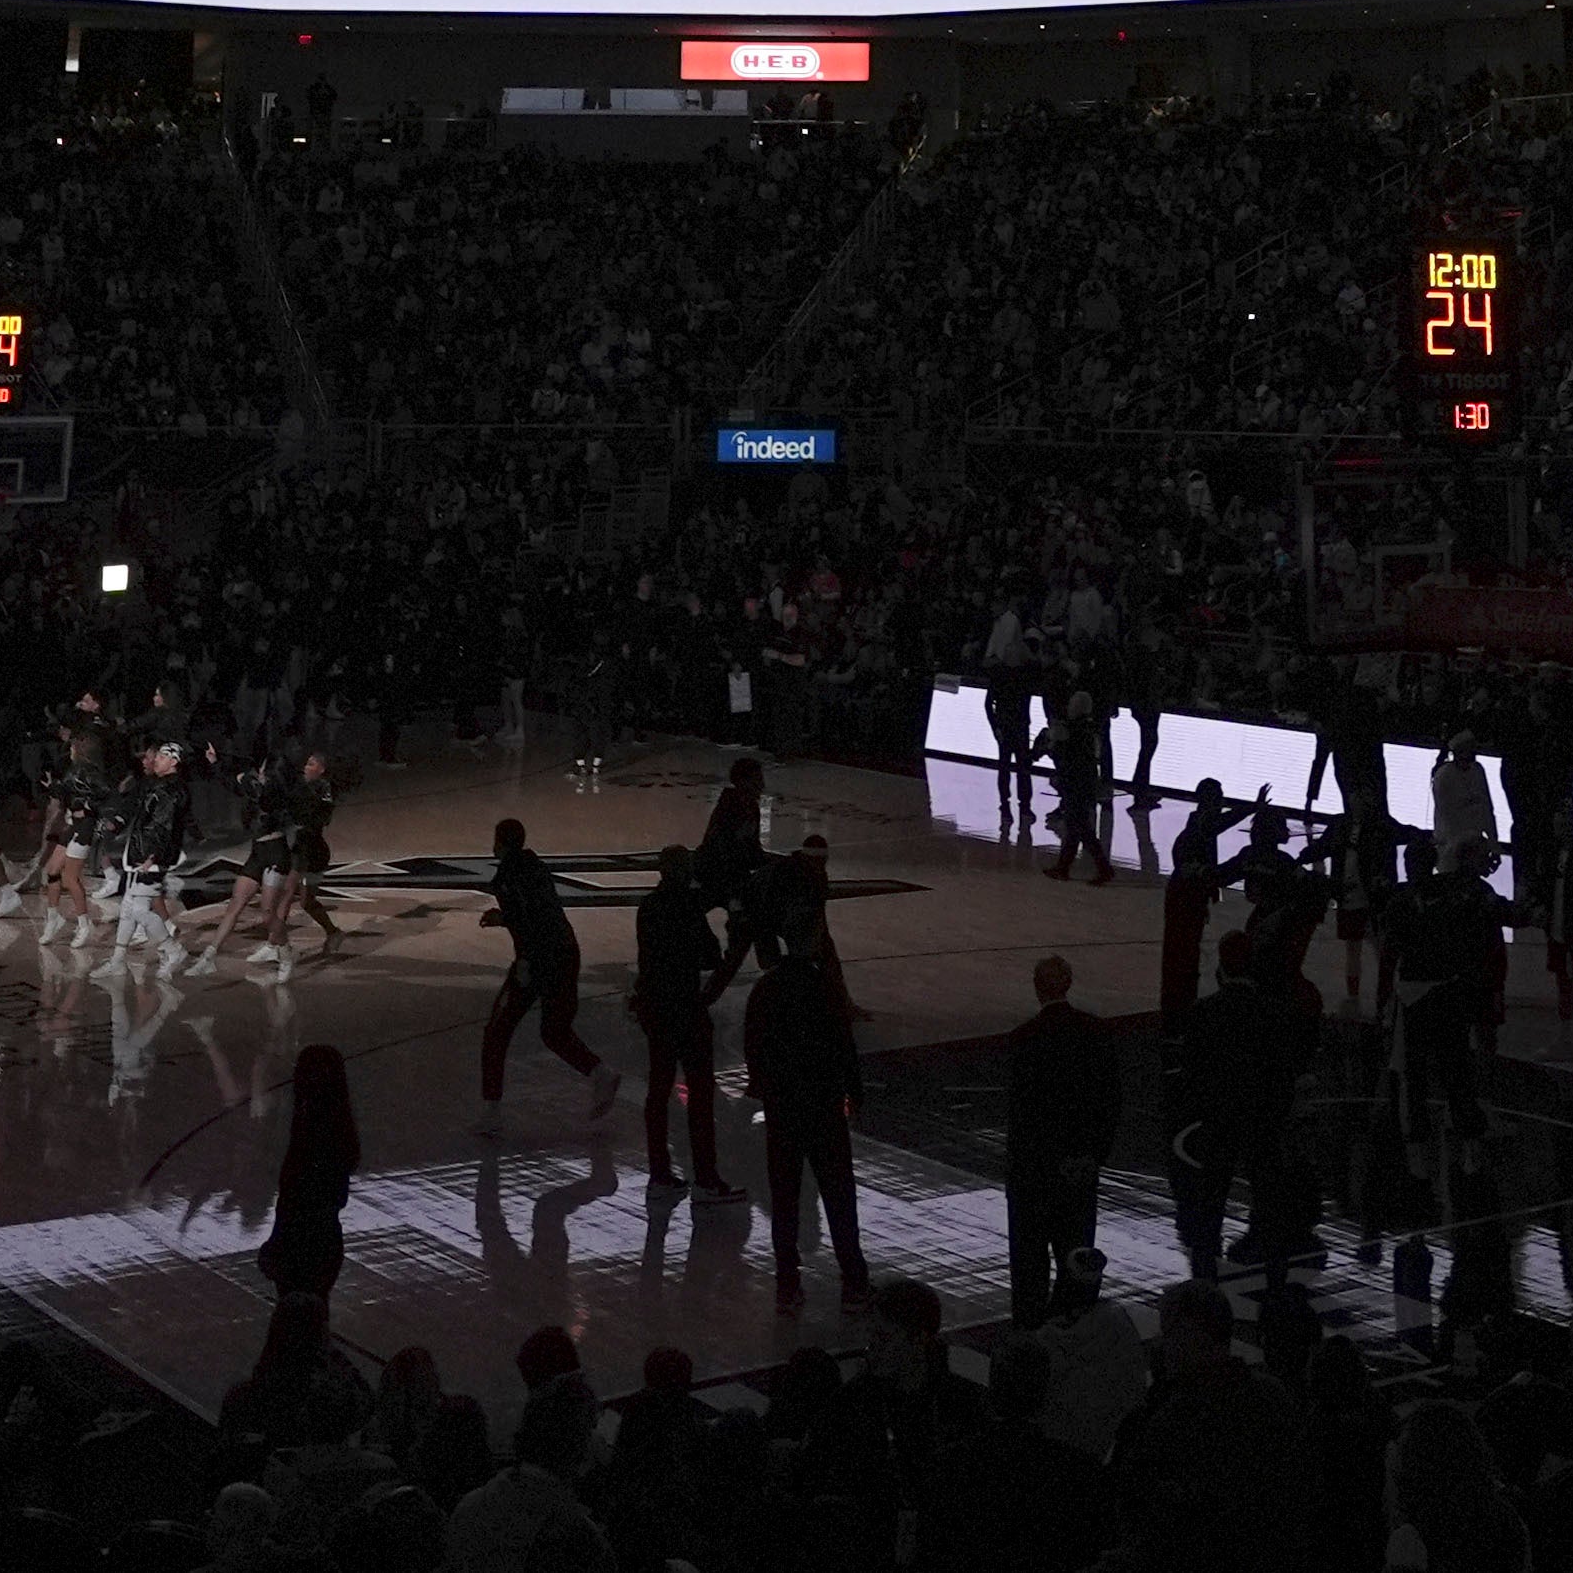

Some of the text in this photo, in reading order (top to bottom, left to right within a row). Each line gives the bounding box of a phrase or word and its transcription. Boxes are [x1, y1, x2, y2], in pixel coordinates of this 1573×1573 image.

[1429, 252, 1497, 289] 12:00
[1425, 291, 1493, 356] 24
[1454, 403, 1490, 430] 1:30
[731, 431, 815, 460] indeed
